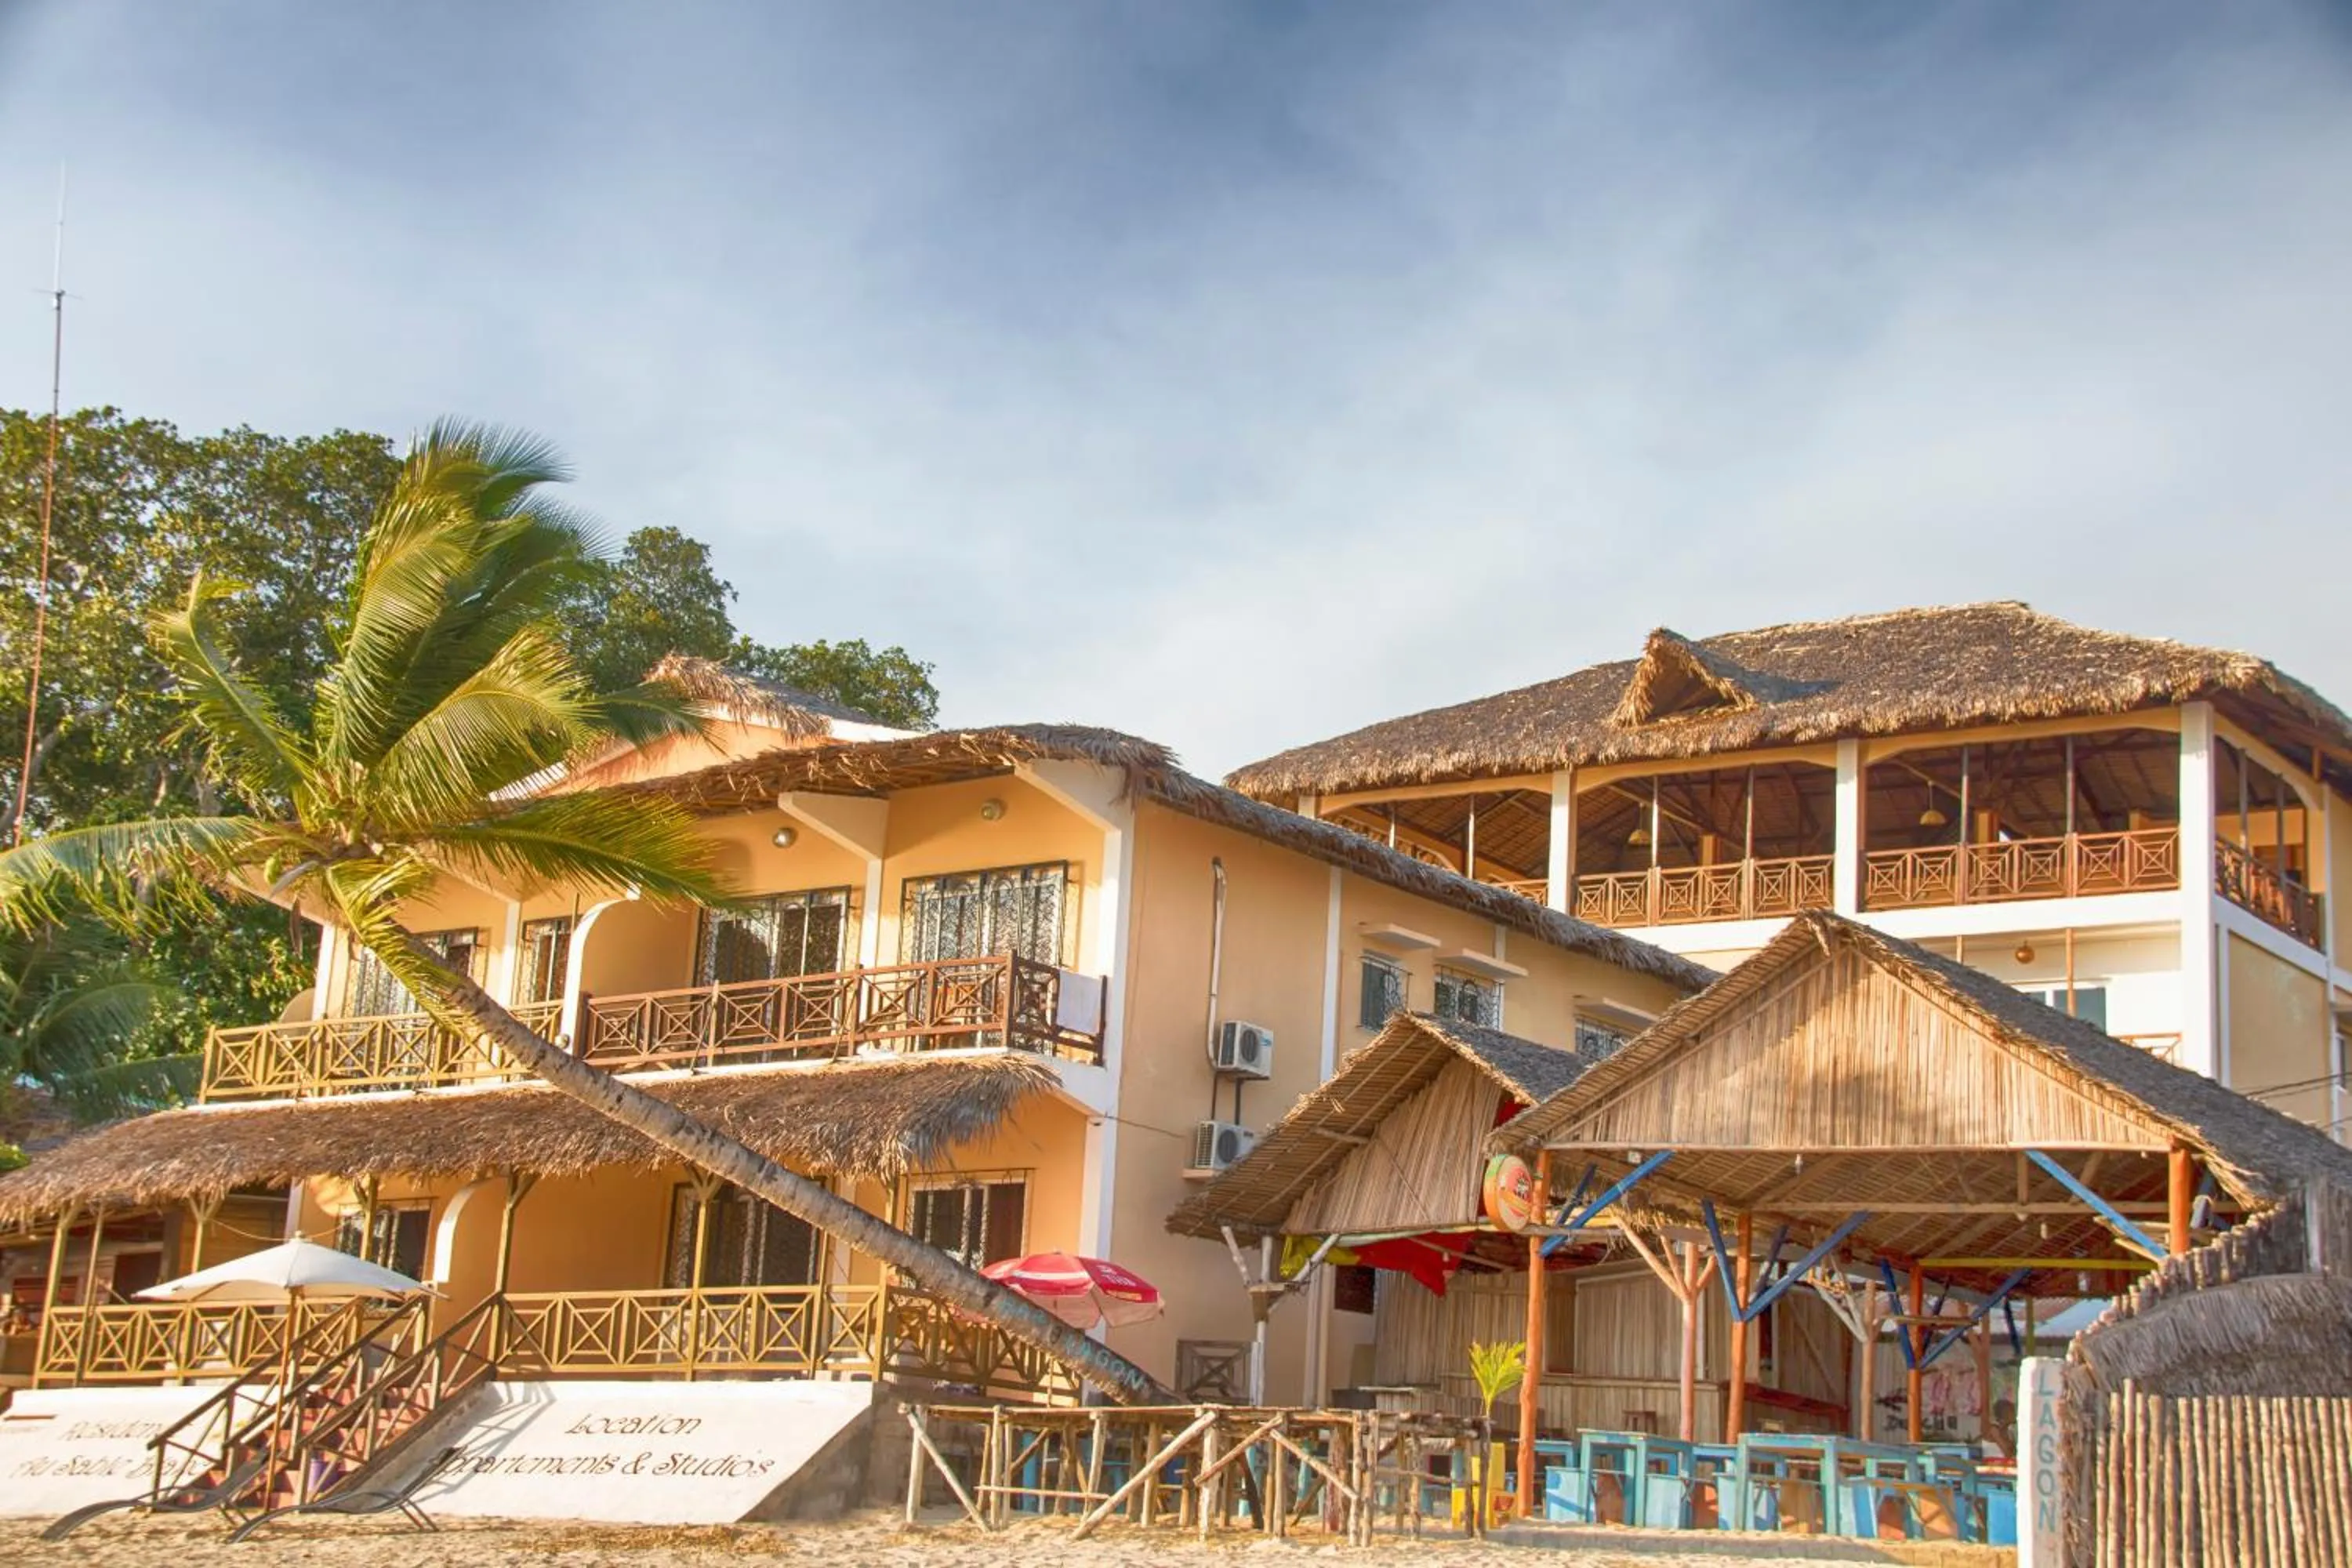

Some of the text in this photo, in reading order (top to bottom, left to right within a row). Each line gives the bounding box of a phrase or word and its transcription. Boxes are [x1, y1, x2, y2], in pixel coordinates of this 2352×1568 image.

[564, 1413, 702, 1435] Location
[434, 1450, 776, 1478] ppartements & Studio's
[2035, 1369, 2057, 1533] LAGON
